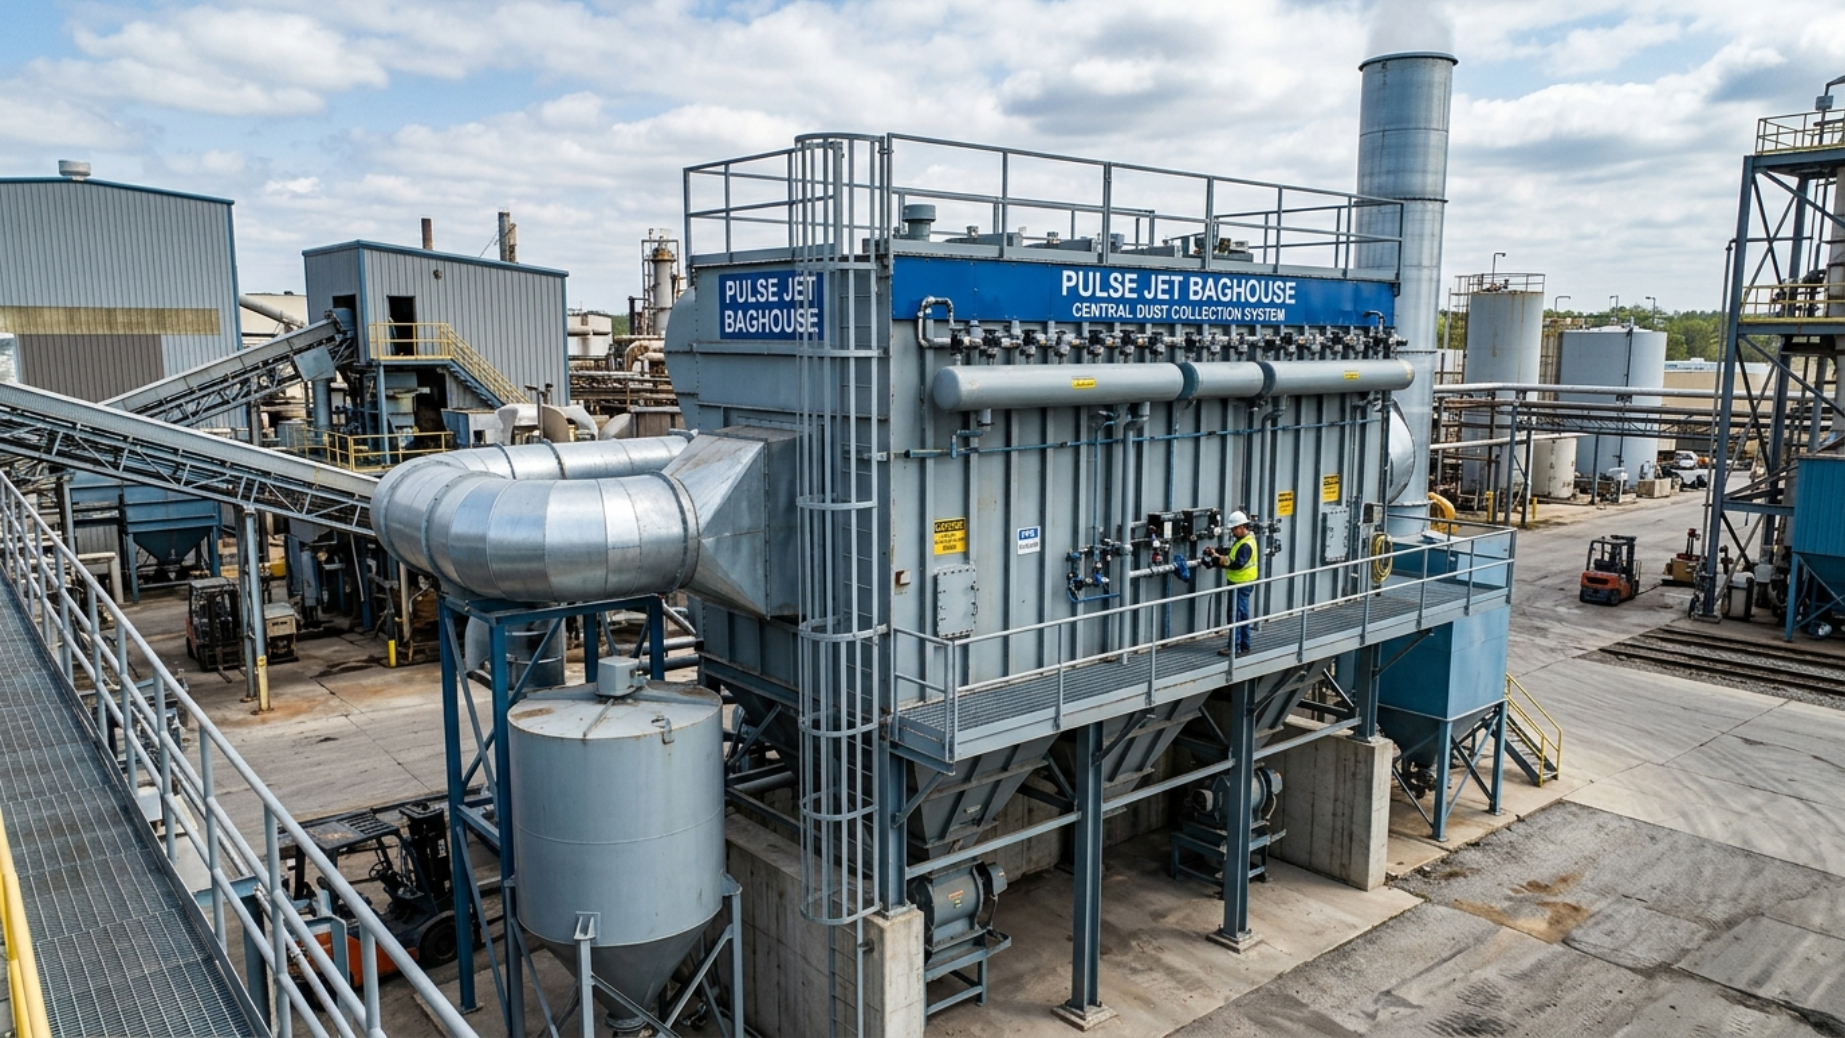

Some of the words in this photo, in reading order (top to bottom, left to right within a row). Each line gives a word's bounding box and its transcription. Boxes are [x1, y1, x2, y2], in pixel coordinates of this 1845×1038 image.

[726, 278, 779, 304] PULSE
[783, 276, 817, 302] JET
[1062, 269, 1138, 299] PULSE
[1143, 274, 1184, 301] JET
[1189, 276, 1297, 305] BAGHOUSE
[724, 308, 819, 334] BAGHOUSE
[1072, 302, 1134, 319] CENTRAL
[1136, 304, 1169, 319] DUST
[1171, 305, 1242, 321] COLLECTION
[1244, 307, 1286, 322] SYSTEM
